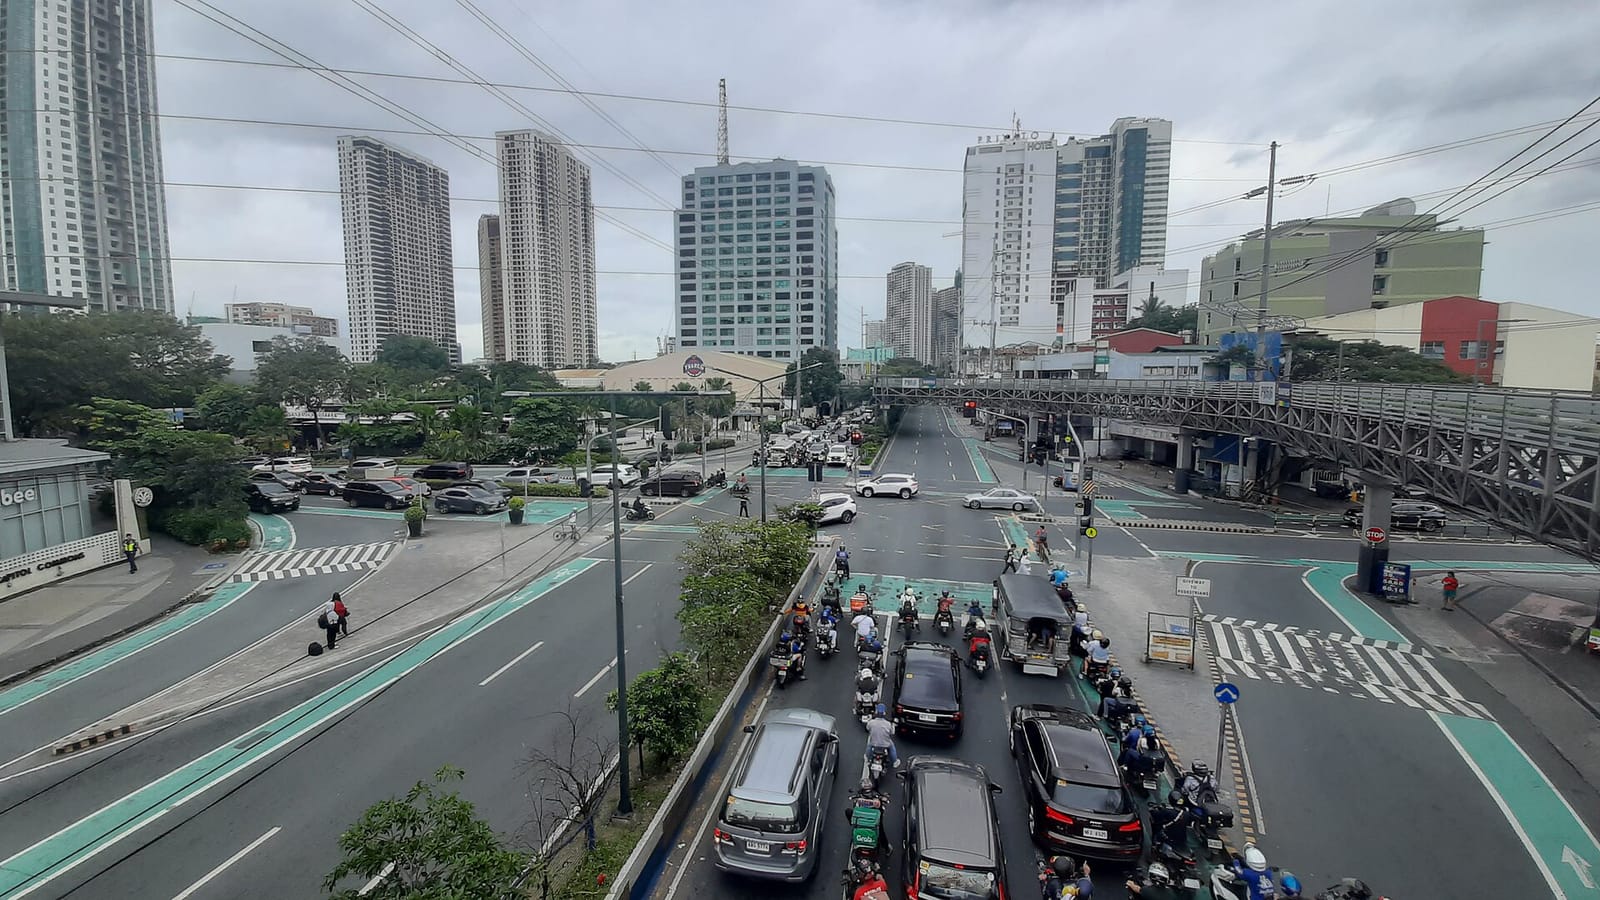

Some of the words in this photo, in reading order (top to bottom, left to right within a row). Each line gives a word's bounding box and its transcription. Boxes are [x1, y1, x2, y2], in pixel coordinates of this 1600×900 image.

[1, 488, 35, 506] bee
[37, 552, 85, 571] COMMONS
[856, 834, 872, 843] Grab
